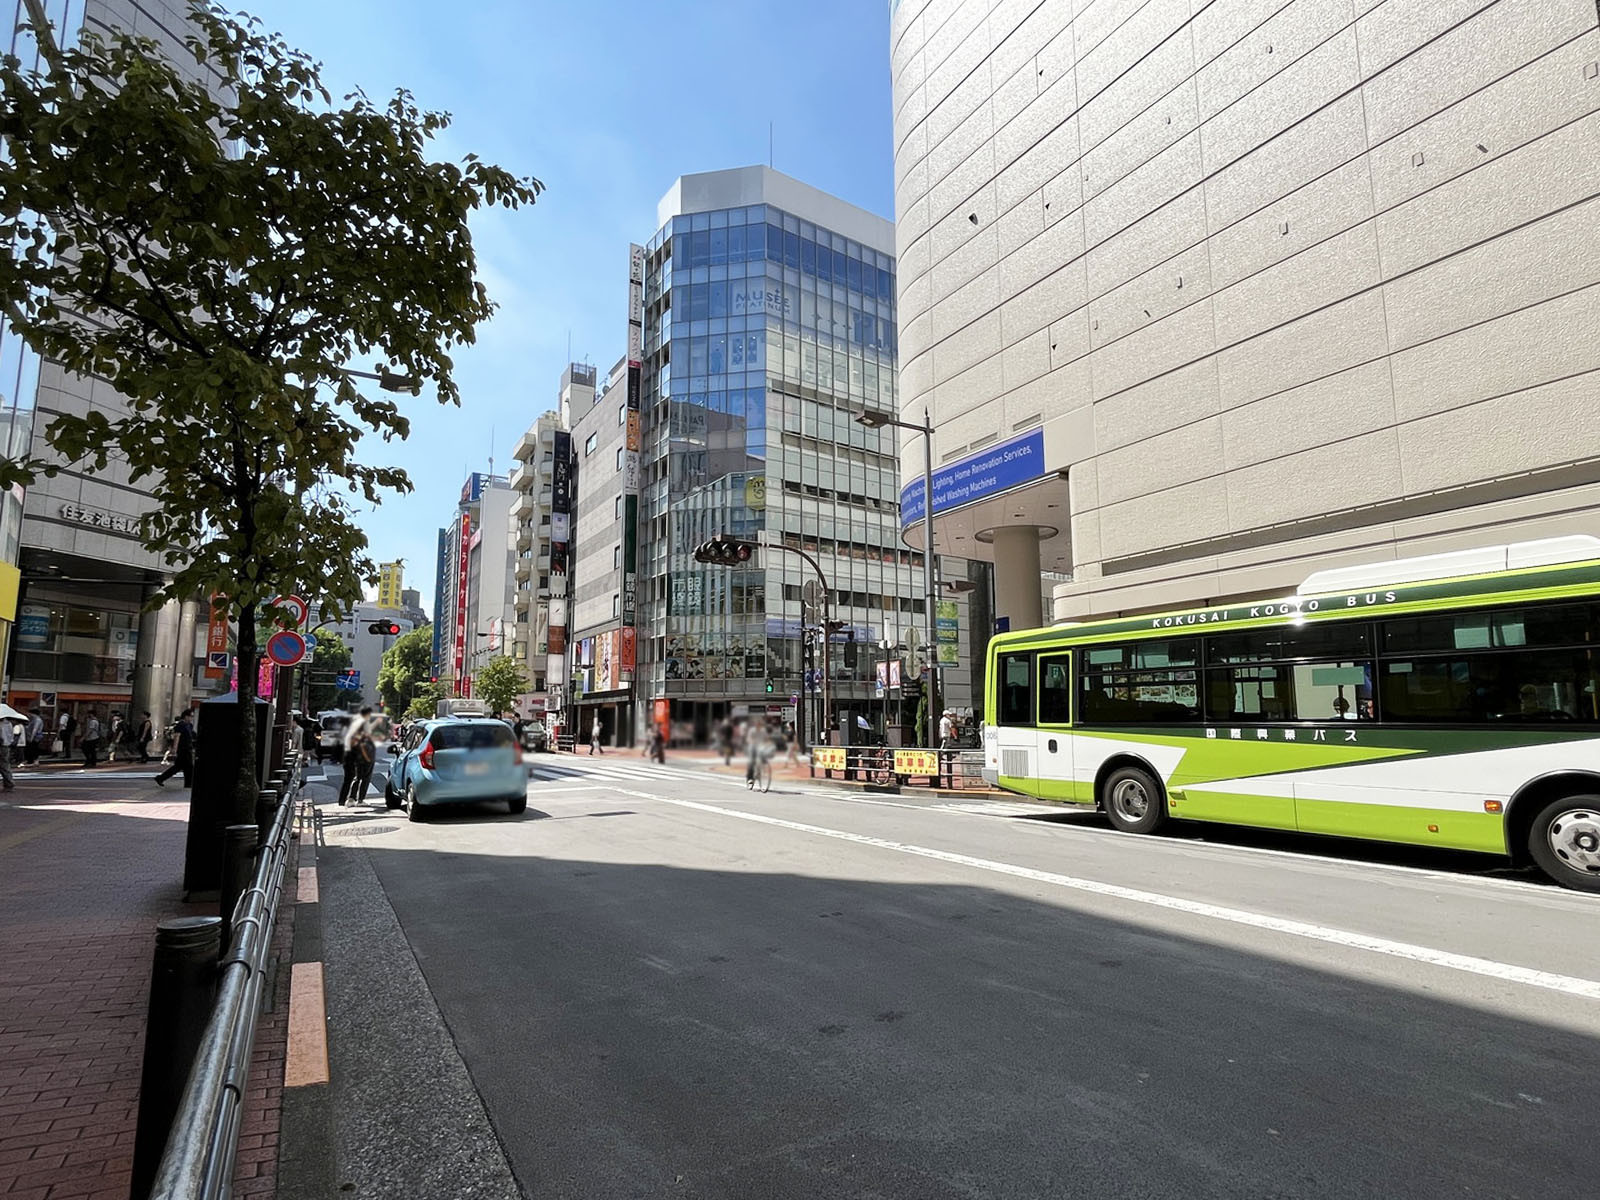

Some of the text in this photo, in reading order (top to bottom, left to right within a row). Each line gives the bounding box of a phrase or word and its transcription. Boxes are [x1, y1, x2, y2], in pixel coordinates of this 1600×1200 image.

[955, 468, 971, 481] Home
[972, 456, 1004, 474] Renovation
[1004, 444, 1033, 463] Services,
[947, 485, 970, 502] Washing
[970, 476, 997, 492] Machines
[1152, 591, 1396, 628] KOKUSAI KOGYO BUS
